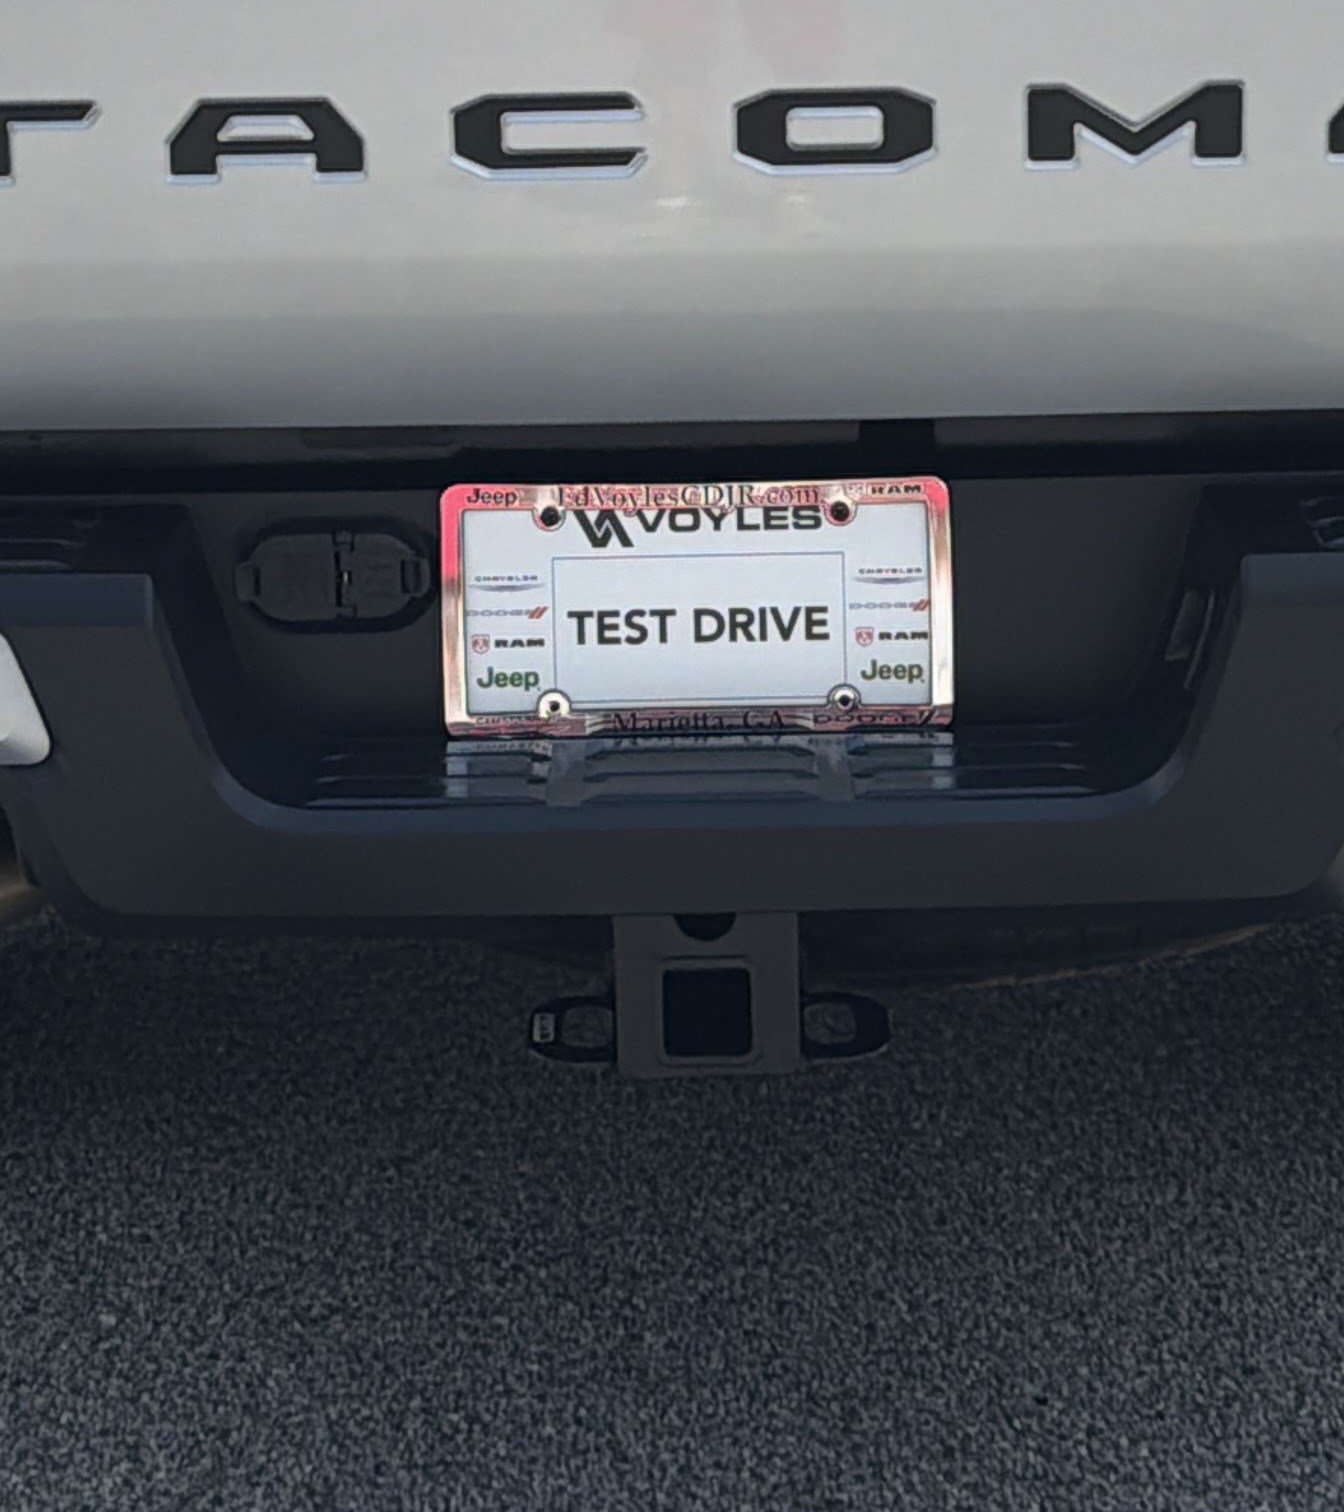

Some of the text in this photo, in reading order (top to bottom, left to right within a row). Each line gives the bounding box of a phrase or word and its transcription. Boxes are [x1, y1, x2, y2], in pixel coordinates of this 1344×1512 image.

[466, 487, 519, 506] Jeep
[870, 484, 922, 495] RAM
[636, 505, 823, 533] VOYLES
[566, 605, 830, 645] TEST DRIVE
[494, 638, 545, 648] RAM
[878, 631, 928, 640] RAM
[477, 666, 540, 691] Jeep
[860, 658, 923, 684] Jeep
[742, 709, 784, 729] GA
